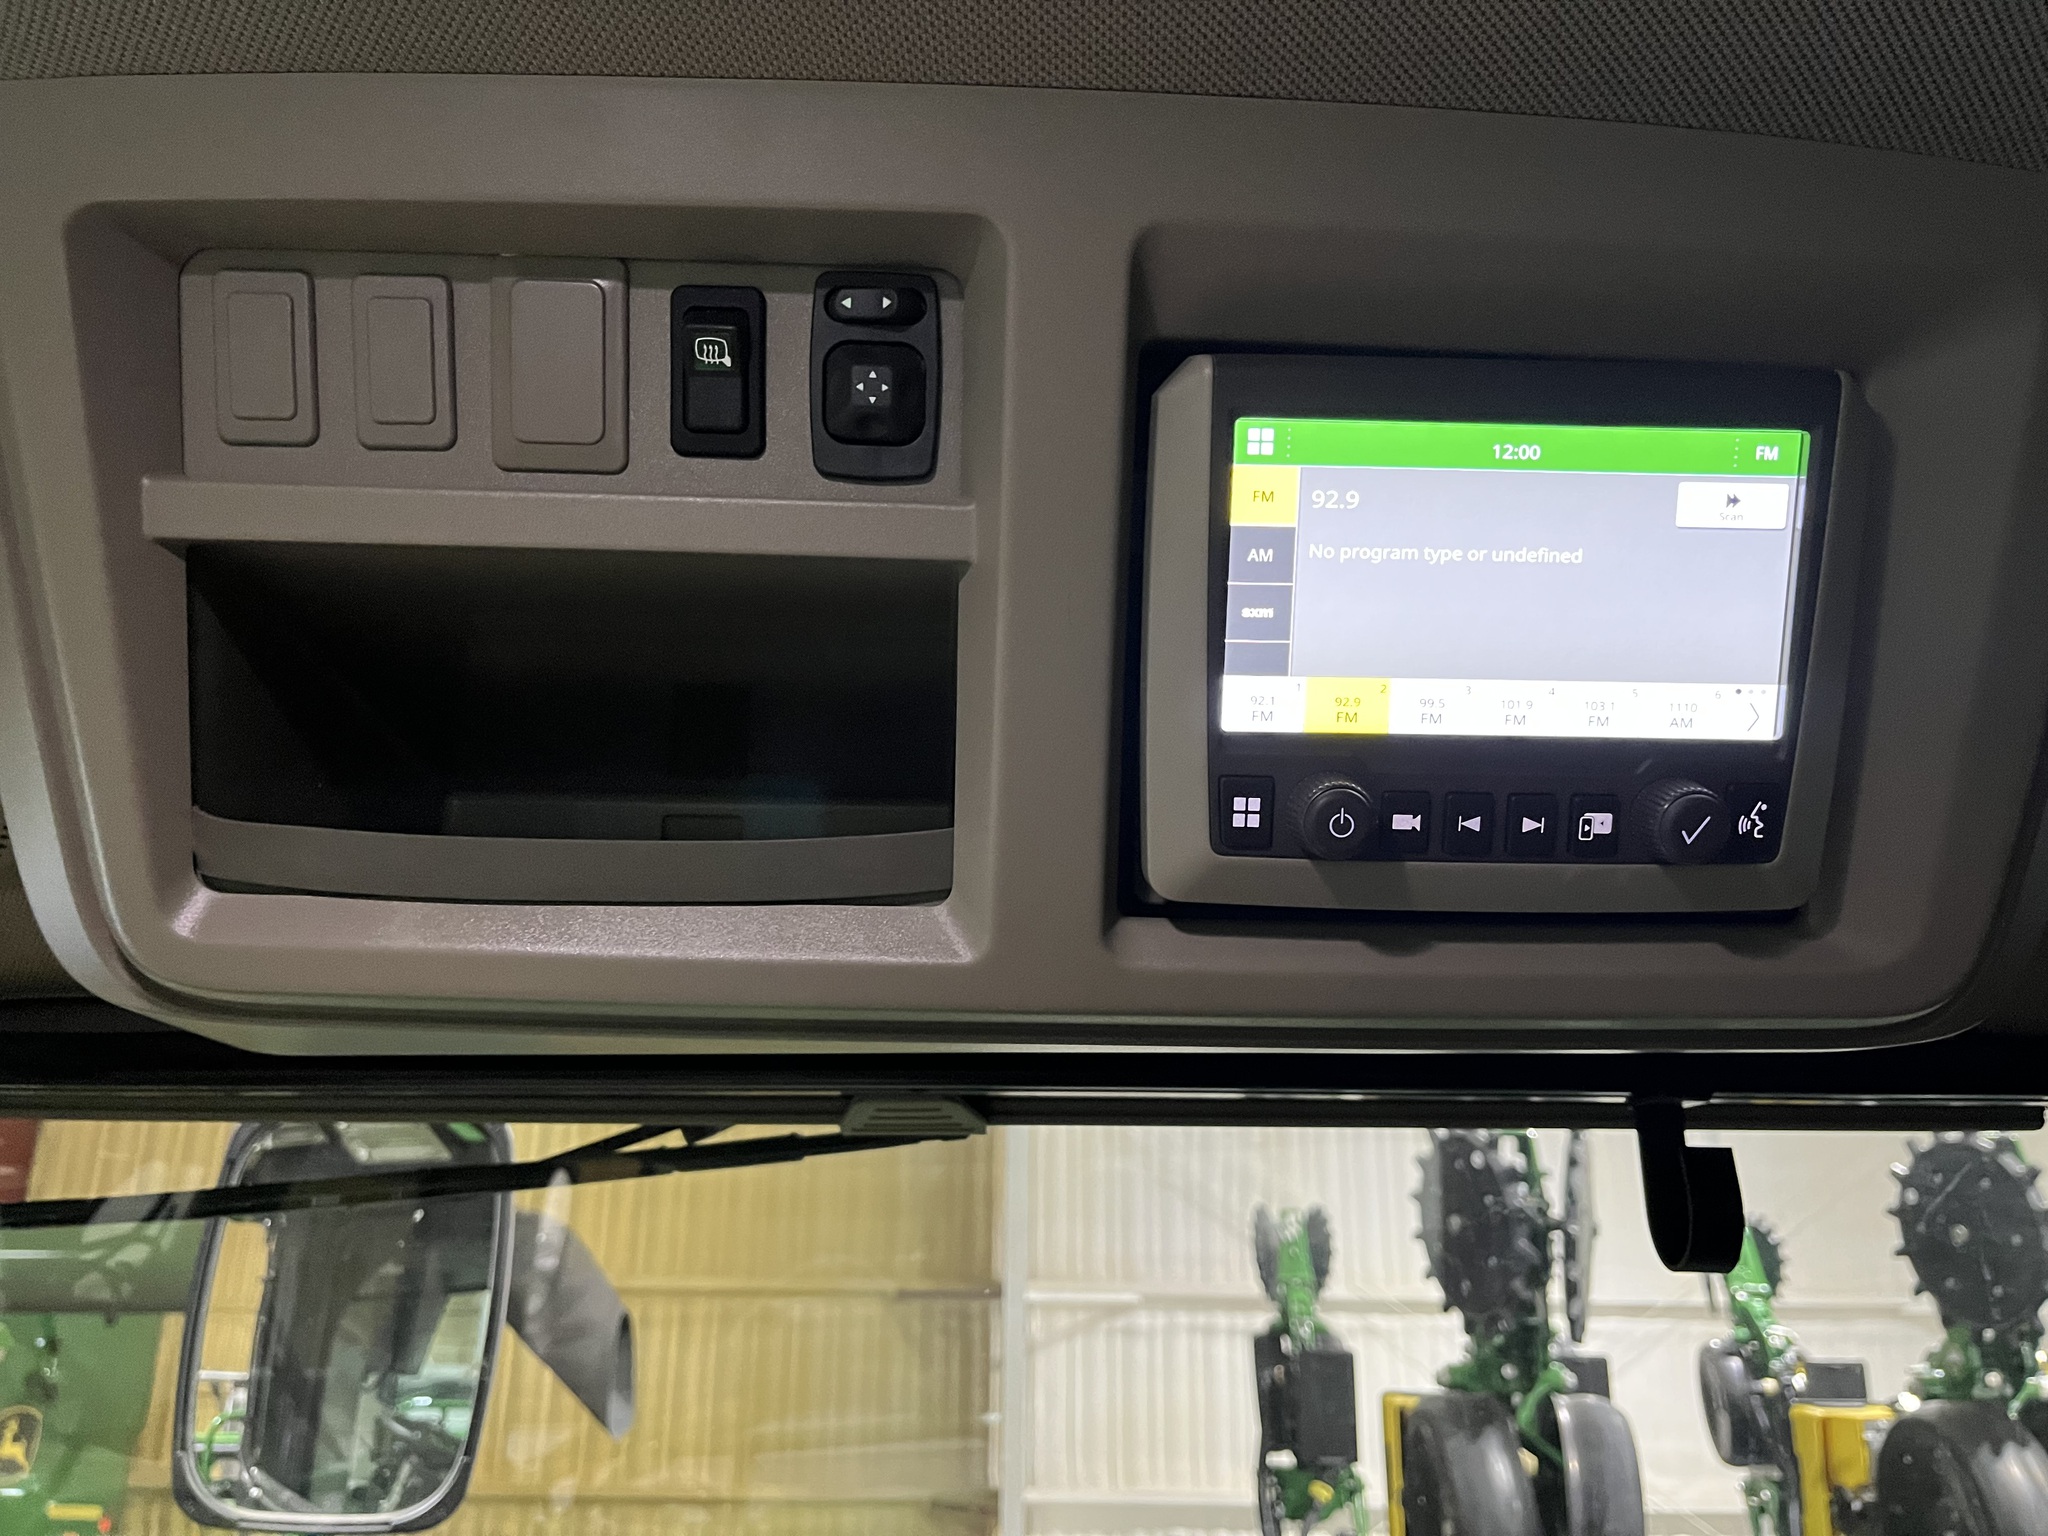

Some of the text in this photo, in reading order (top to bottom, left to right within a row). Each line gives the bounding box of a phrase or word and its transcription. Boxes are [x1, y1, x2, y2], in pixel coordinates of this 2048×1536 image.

[1492, 444, 1541, 460] 12:00
[1755, 446, 1779, 461] FM
[1252, 490, 1275, 503] FM
[1311, 489, 1360, 509] 92.9
[1719, 512, 1744, 521] Scan
[1246, 548, 1274, 563] AM
[1308, 543, 1583, 565] No program type or undefined
[1380, 684, 1387, 694] 2
[1466, 686, 1472, 695] 3
[1549, 688, 1555, 696] 4
[1632, 689, 1638, 698] 5
[1715, 690, 1721, 699] 6
[1250, 696, 1275, 706] 92.1
[1334, 697, 1361, 708] 92.9
[1419, 699, 1446, 709] 99.5
[1501, 700, 1533, 710] 1019
[1585, 701, 1615, 711] 1031
[1252, 711, 1274, 722] FM
[1336, 712, 1358, 723] FM
[1421, 713, 1442, 724] FM
[1505, 714, 1526, 726] FM
[1588, 716, 1609, 727] FM
[1669, 717, 1693, 728] AM
